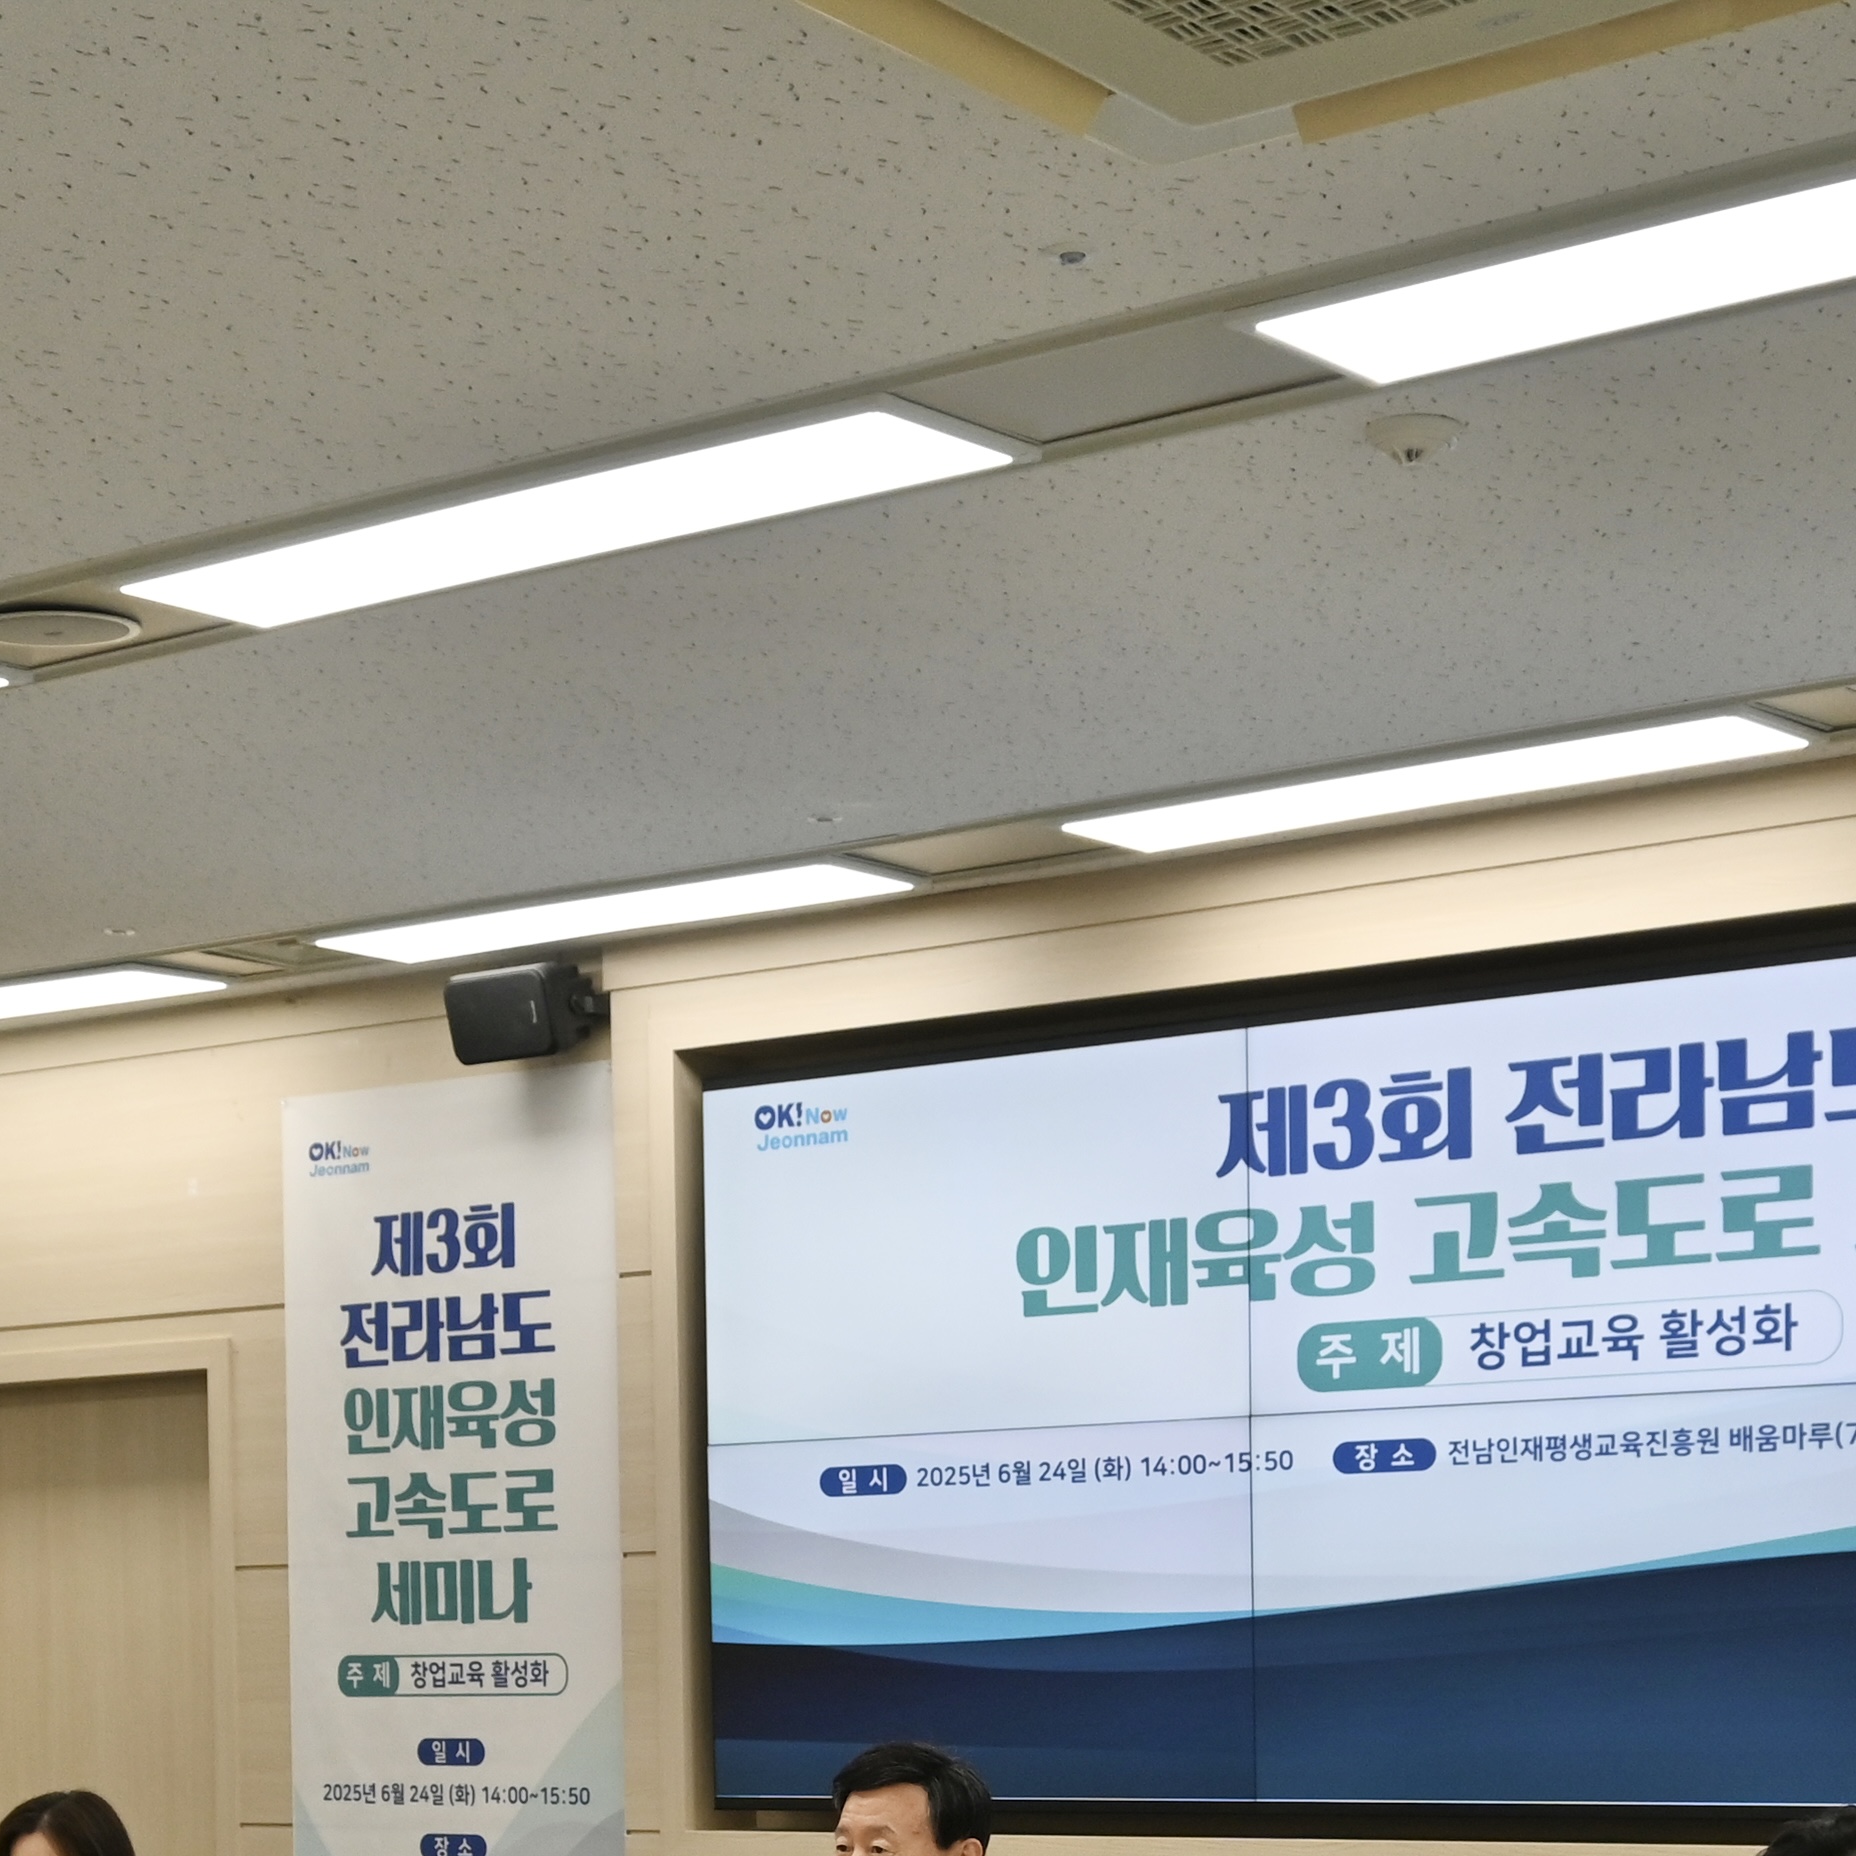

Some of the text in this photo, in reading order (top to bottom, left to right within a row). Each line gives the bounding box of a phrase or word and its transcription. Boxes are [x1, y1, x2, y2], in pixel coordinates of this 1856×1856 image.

[755, 1101, 848, 1131] OK! Now
[757, 1129, 848, 1151] Jeonnam
[1215, 1061, 1473, 1183] 제3회
[309, 1140, 342, 1161] OK!
[309, 1162, 370, 1177] Jeonnam
[370, 1201, 516, 1278] 제3회
[1015, 1197, 1380, 1323] 인재육성
[1408, 1162, 1822, 1286] 고속도로
[340, 1289, 556, 1369] 전라남도
[1469, 1314, 1645, 1371] 창업교육
[1659, 1302, 1799, 1360] 활성화
[343, 1377, 557, 1455] 인재육성
[916, 1462, 991, 1488] 2025년
[997, 1458, 1033, 1490] 6월
[1038, 1456, 1089, 1488] 24일
[1094, 1454, 1132, 1485] (화)
[1140, 1445, 1294, 1482] 14:00~15:50
[1447, 1425, 1721, 1468] 전남인재평생교육진흥원
[345, 1468, 559, 1540] 고속도로
[370, 1557, 533, 1626] 세미나
[410, 1660, 486, 1689] 창업교육
[490, 1659, 550, 1689] 활성화
[323, 1782, 591, 1808] 2025년 6월 24일 (화) 14:00~15:50
